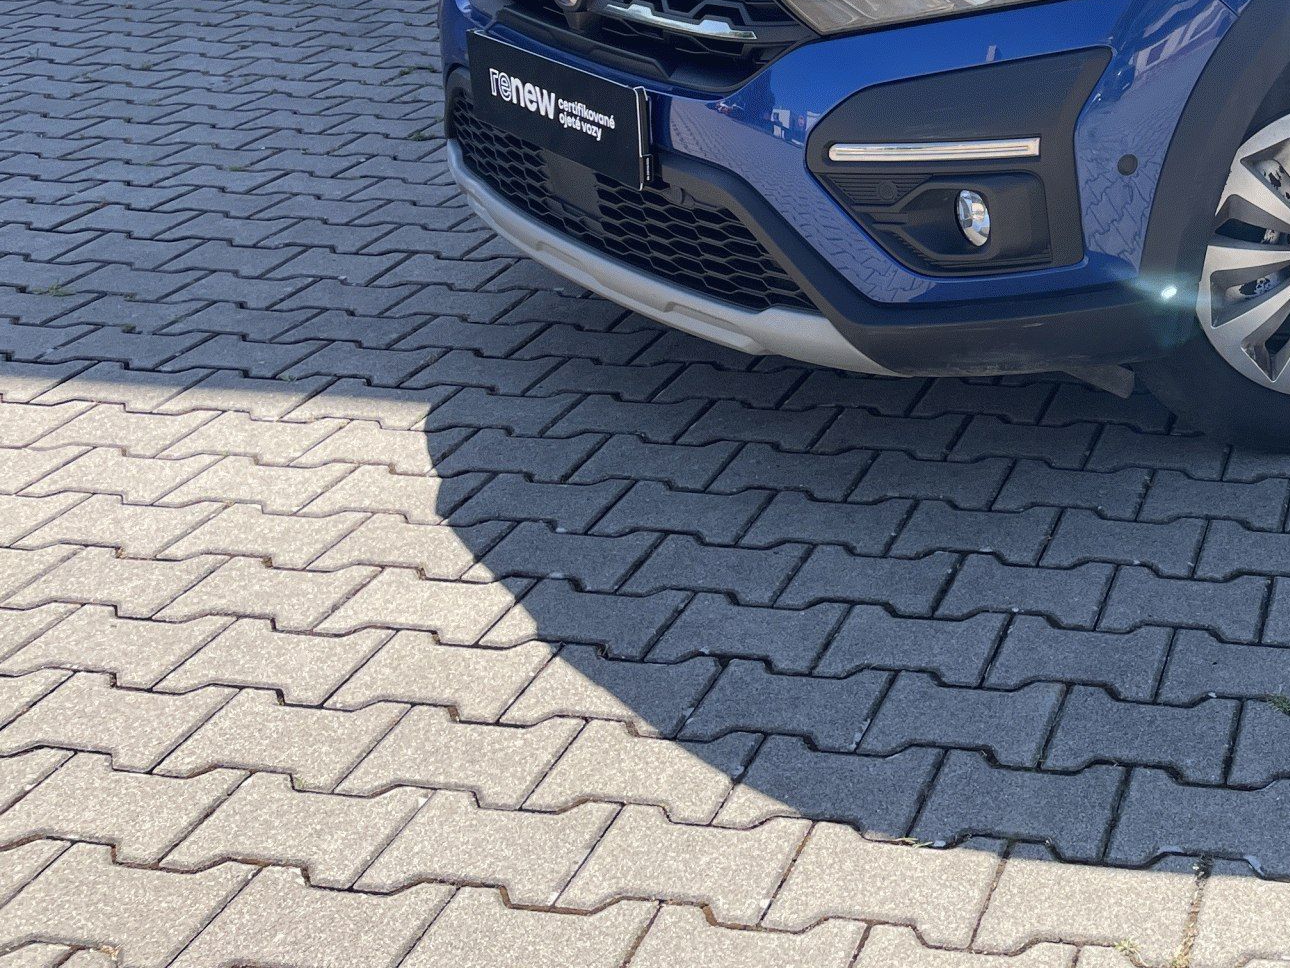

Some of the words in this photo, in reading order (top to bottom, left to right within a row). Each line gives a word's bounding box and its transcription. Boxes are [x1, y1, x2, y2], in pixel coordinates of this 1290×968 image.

[489, 68, 556, 120] renew
[557, 98, 616, 129] certifikované
[558, 112, 581, 131] ojeté
[581, 120, 602, 141] vozy
